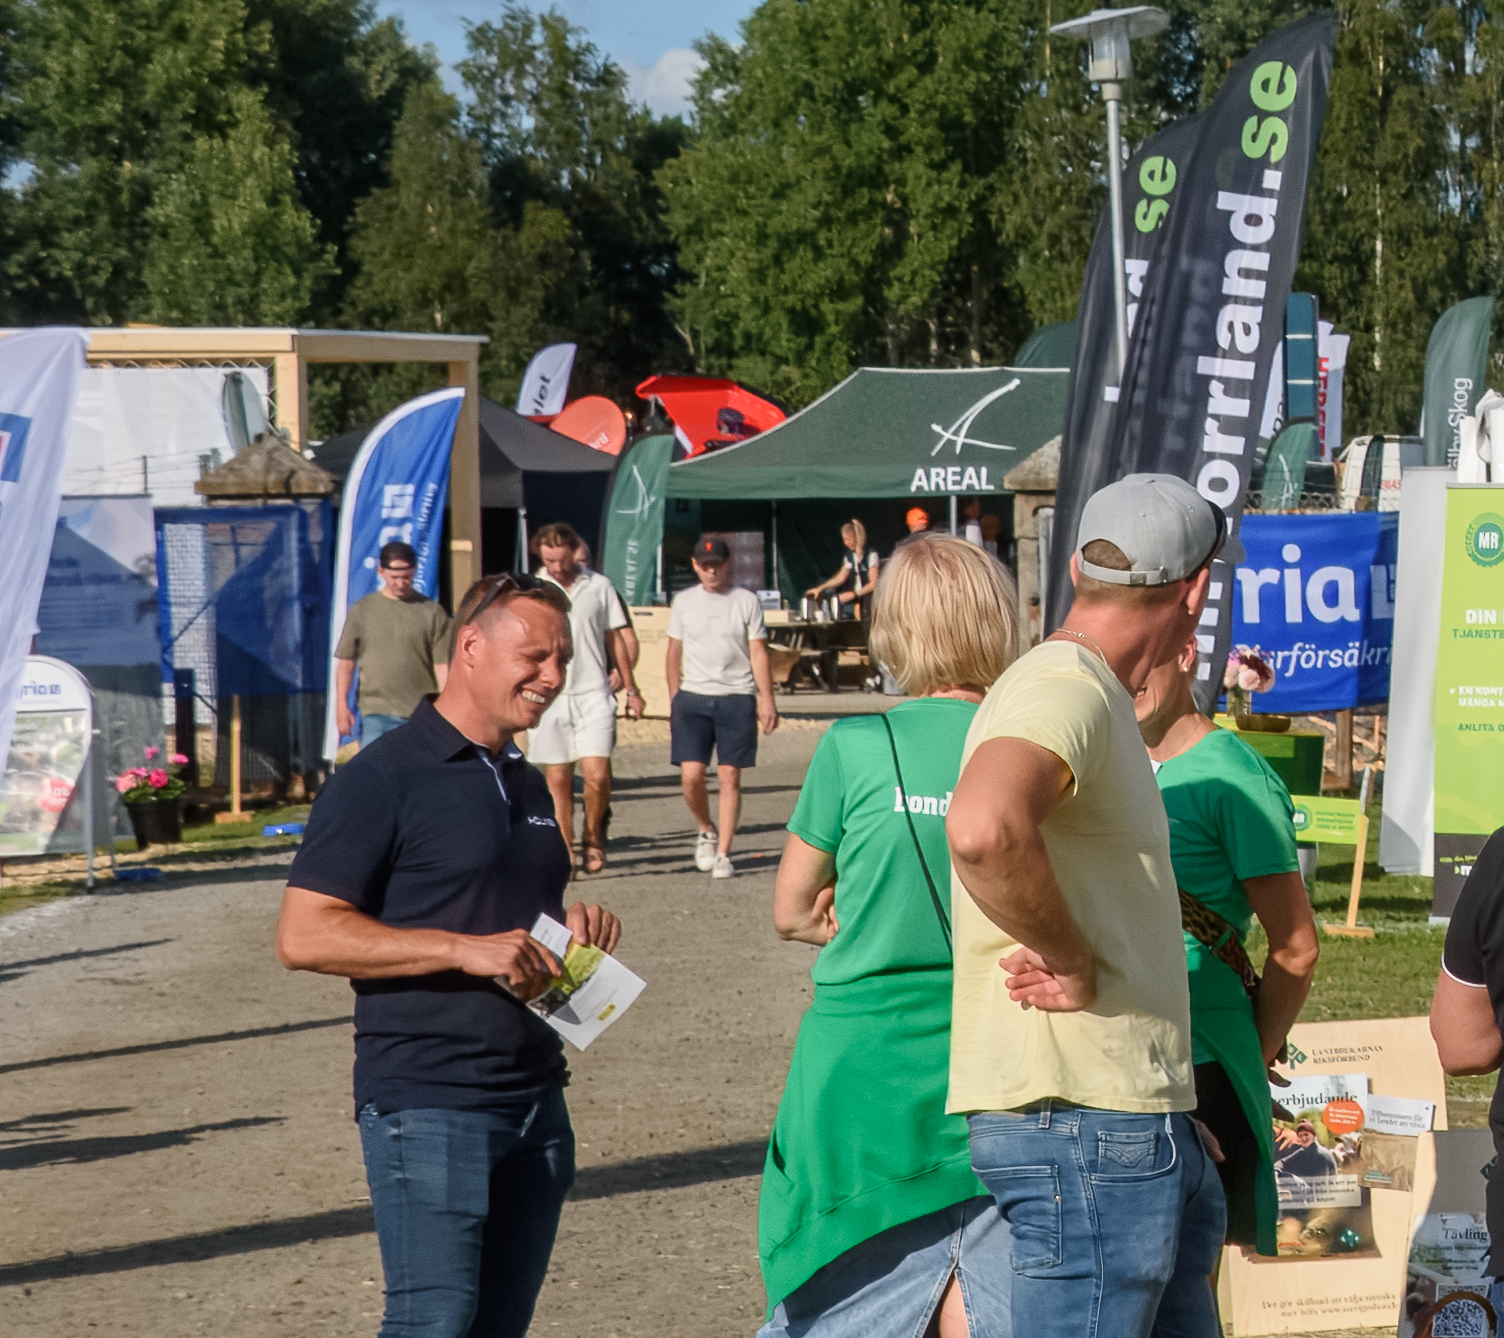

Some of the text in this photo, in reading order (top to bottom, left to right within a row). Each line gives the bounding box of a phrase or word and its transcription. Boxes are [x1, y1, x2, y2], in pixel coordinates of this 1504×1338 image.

[1196, 60, 1298, 539] orrland.se
[911, 466, 995, 493] AREAL
[1235, 542, 1361, 624] ria
[1465, 609, 1498, 625] DIN
